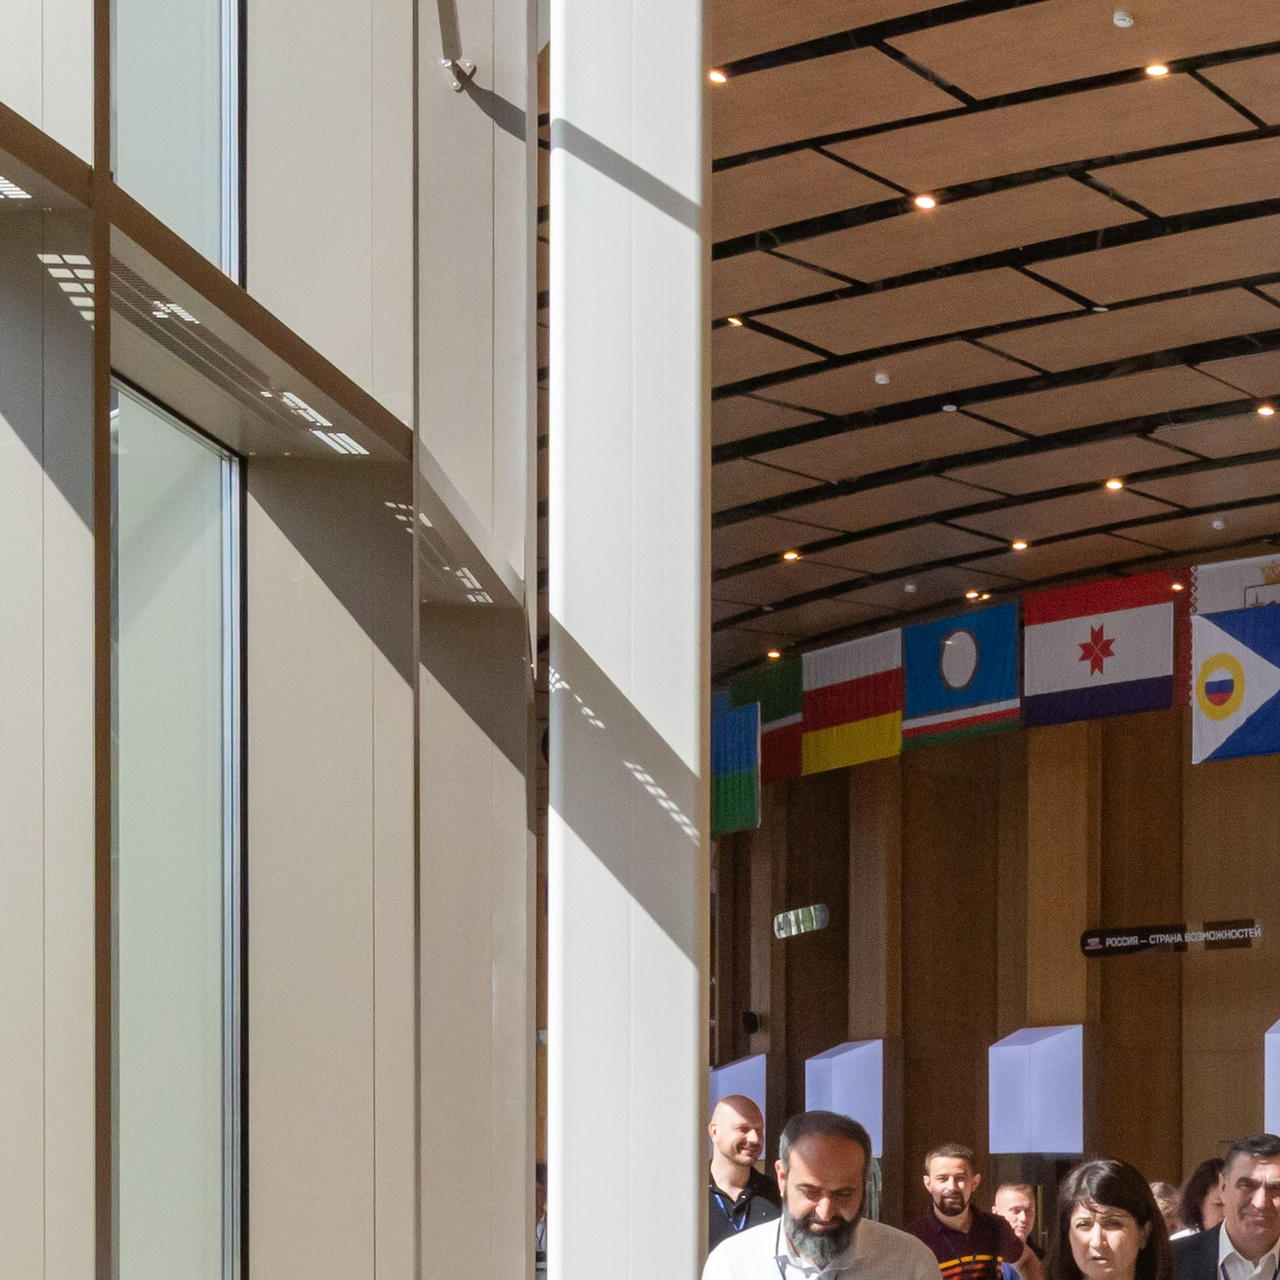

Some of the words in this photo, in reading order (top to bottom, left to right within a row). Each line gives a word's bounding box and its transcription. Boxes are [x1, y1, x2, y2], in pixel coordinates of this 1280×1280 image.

[1105, 935, 1139, 947] РОССИЯ
[1149, 933, 1182, 945] СТРАНА
[1184, 924, 1261, 942] ВОЗМОЖНОСТЕЙ
